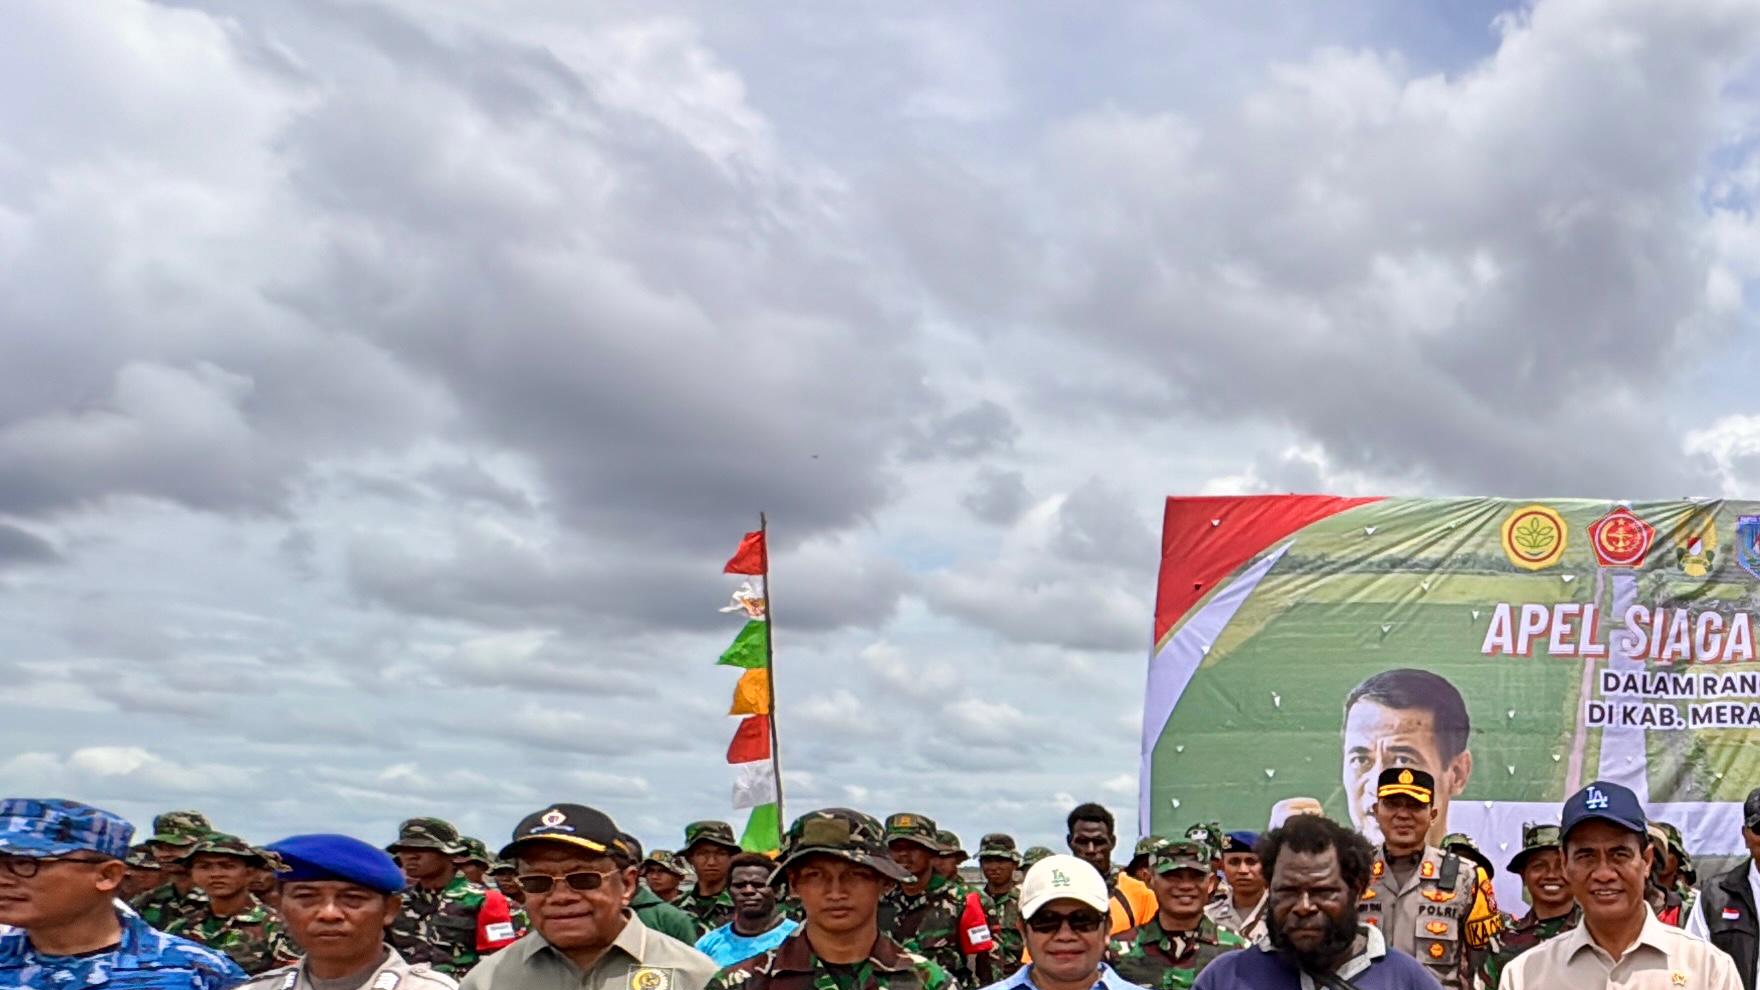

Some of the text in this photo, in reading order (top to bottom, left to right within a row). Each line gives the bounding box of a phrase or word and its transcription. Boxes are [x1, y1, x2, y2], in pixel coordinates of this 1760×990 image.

[1481, 602, 1607, 657] APEL
[1621, 604, 1755, 663] SIAGA
[1603, 672, 1695, 696] DALAM
[1587, 703, 1613, 724] DI
[1621, 705, 1684, 726] KAB.
[1586, 786, 1608, 809] LA
[1418, 904, 1457, 917] POLRI
